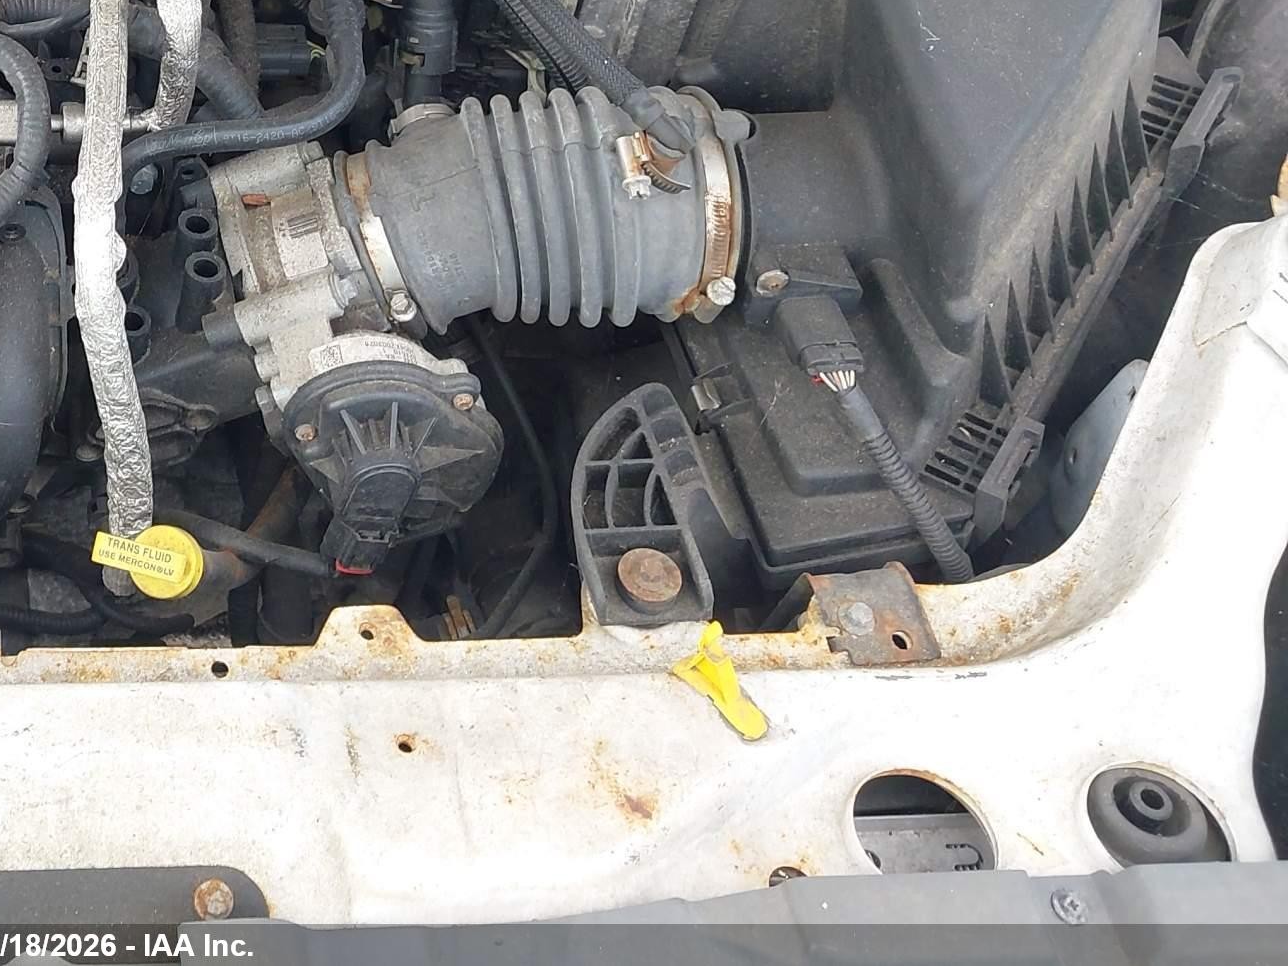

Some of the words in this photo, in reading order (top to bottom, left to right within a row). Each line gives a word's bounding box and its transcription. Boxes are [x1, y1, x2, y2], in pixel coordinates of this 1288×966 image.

[98, 549, 116, 561] USE
[107, 537, 140, 555] TRANS
[143, 547, 172, 564] FLUID
